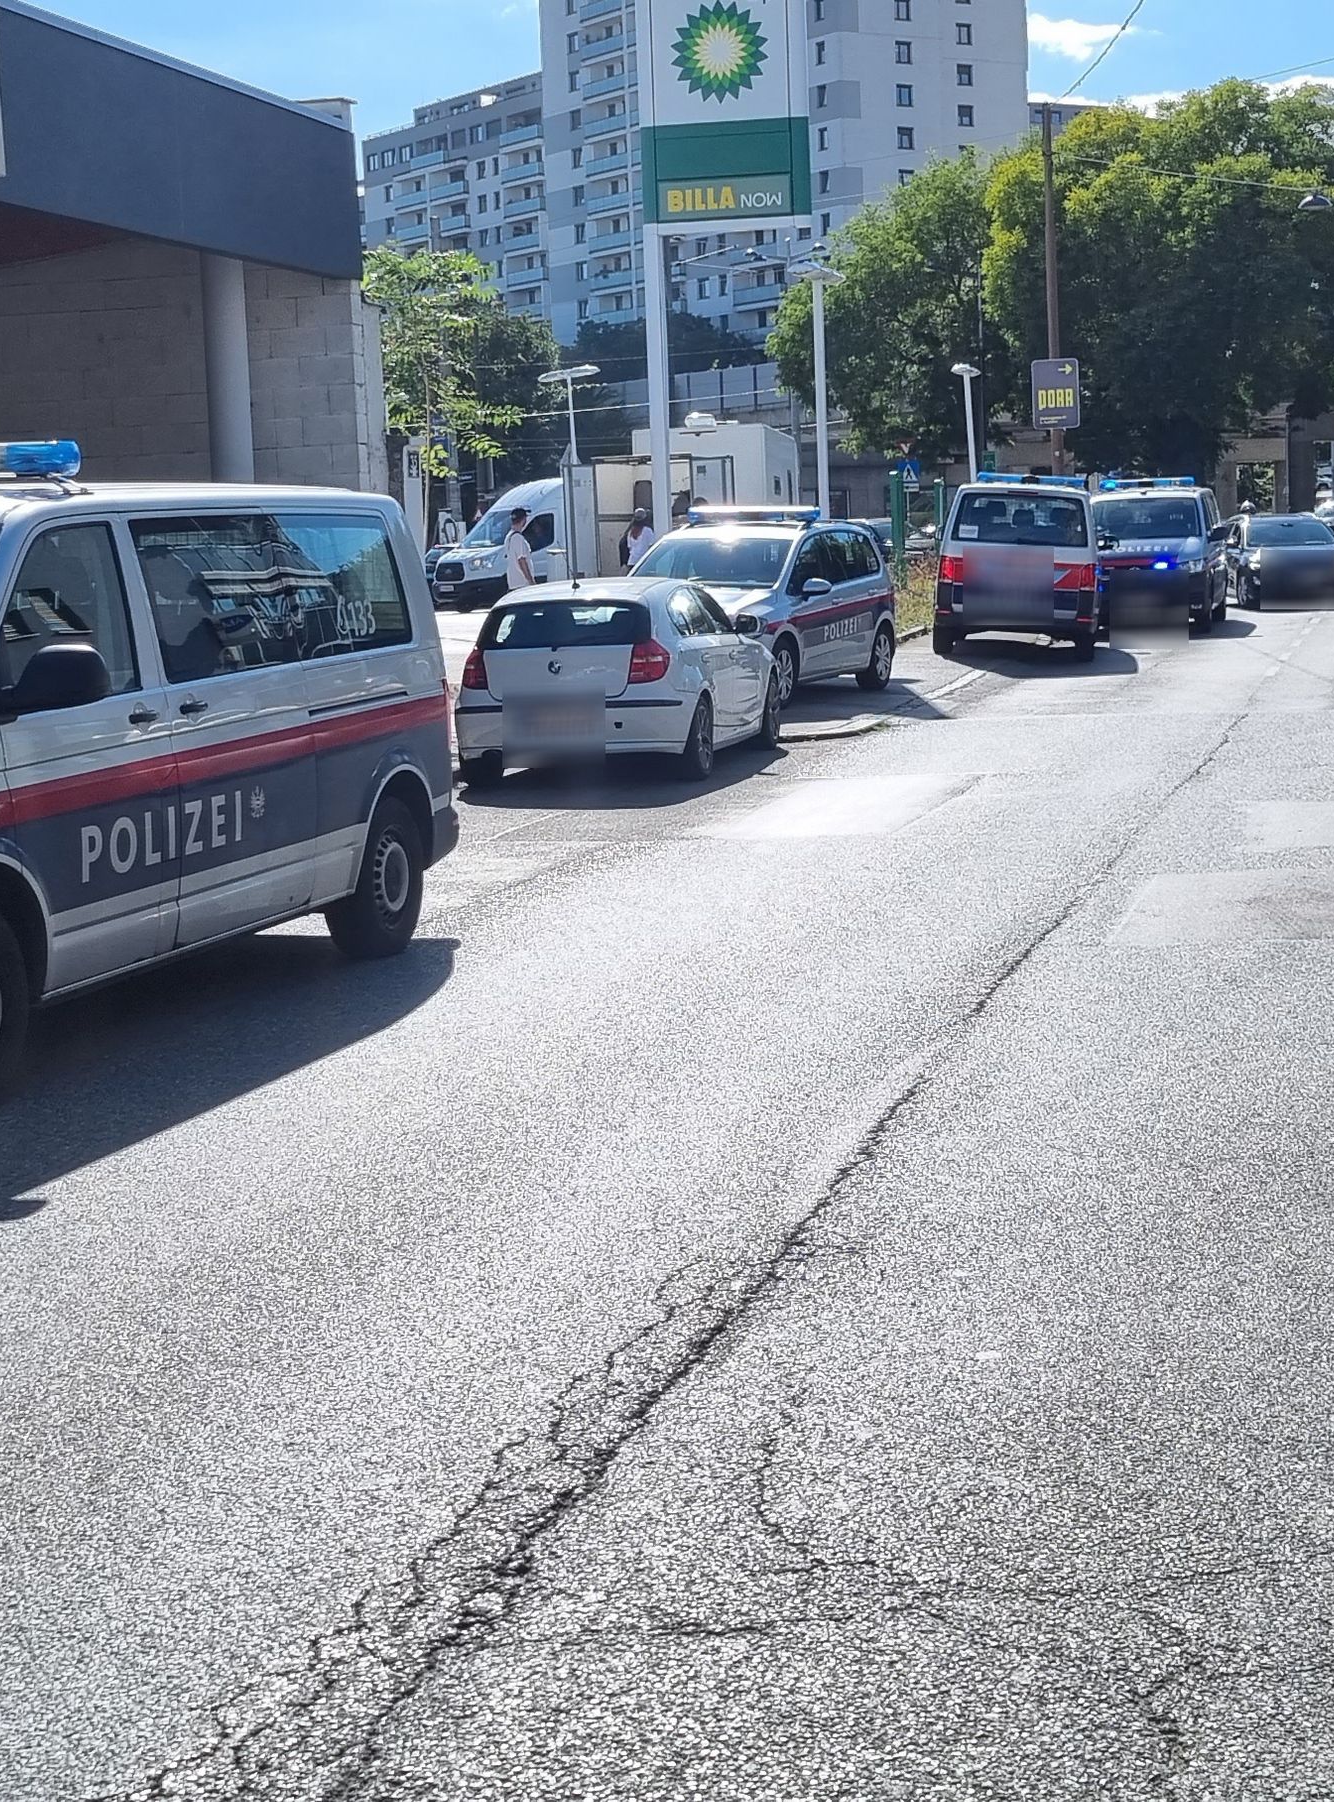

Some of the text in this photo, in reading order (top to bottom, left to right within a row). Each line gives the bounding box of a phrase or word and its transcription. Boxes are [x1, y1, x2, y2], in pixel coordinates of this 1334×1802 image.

[667, 186, 782, 213] BILLA NOW
[824, 617, 858, 642] POLIZEI
[80, 790, 243, 884] POLIZEI
